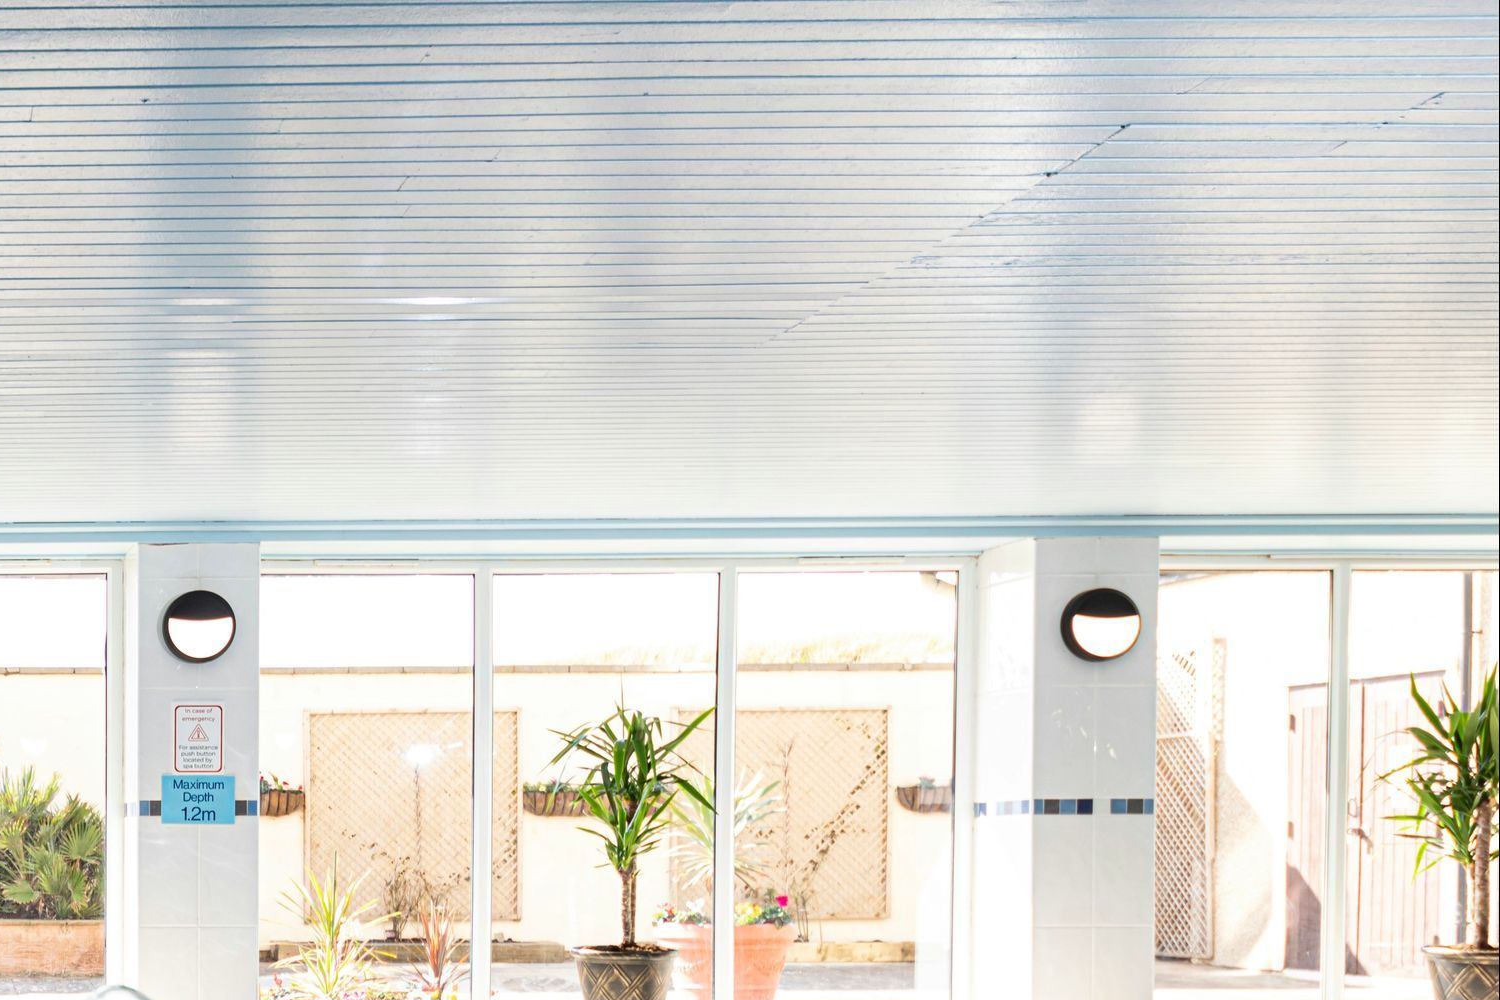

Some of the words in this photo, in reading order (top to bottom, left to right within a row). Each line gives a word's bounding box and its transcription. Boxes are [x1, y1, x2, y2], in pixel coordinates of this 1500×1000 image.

[173, 779, 224, 790] Maximum
[183, 792, 214, 804] Depth
[181, 806, 216, 821] 1.2m
